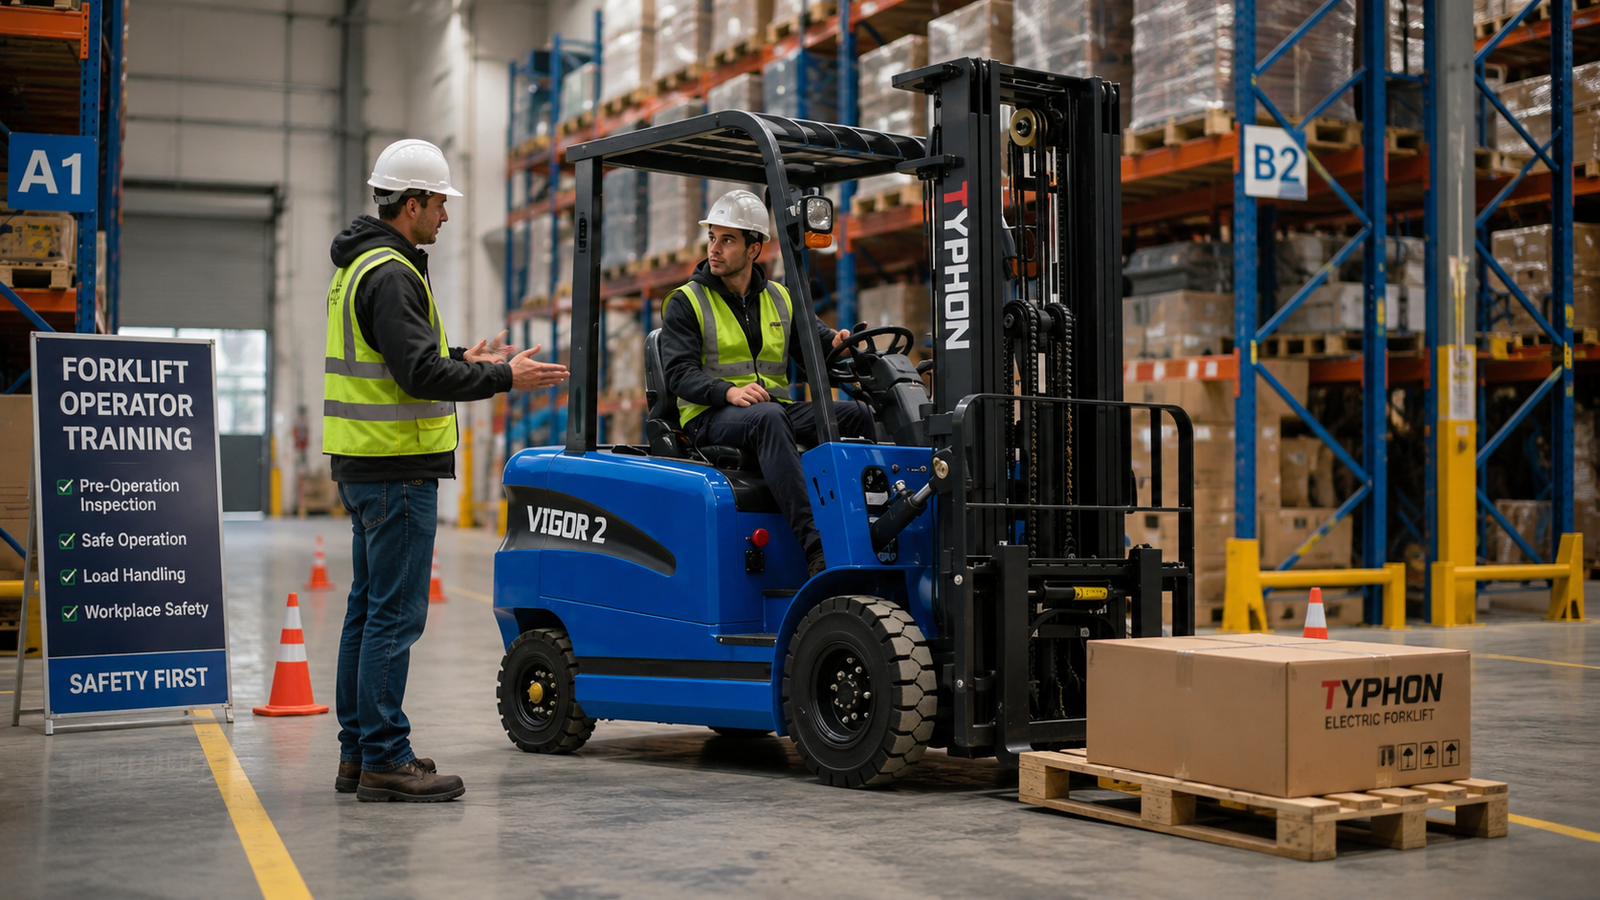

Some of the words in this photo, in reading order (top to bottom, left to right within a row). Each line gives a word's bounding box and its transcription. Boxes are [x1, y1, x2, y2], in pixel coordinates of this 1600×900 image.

[18, 149, 81, 195] A1
[1254, 144, 1299, 182] B2
[944, 180, 970, 350] TYPHON
[62, 356, 189, 384] FORKLIFT
[60, 391, 194, 417] OPERATOR
[63, 426, 192, 451] TRAINING
[80, 478, 180, 497] Pre-Operation
[80, 497, 157, 514] Inspection
[527, 505, 590, 541] VIGOR
[592, 516, 607, 544] 2
[82, 532, 114, 548] Safe
[118, 532, 187, 550] Operation
[83, 567, 118, 583] Load
[123, 566, 186, 584] Handling
[85, 603, 161, 620] Workplace
[165, 601, 209, 619] Safety
[70, 671, 148, 694] SAFETY
[154, 667, 208, 689] FIRST
[1321, 673, 1443, 710] TYPHON
[1325, 713, 1380, 730] ELECTRIC
[1384, 708, 1435, 724] FORKLIFT
